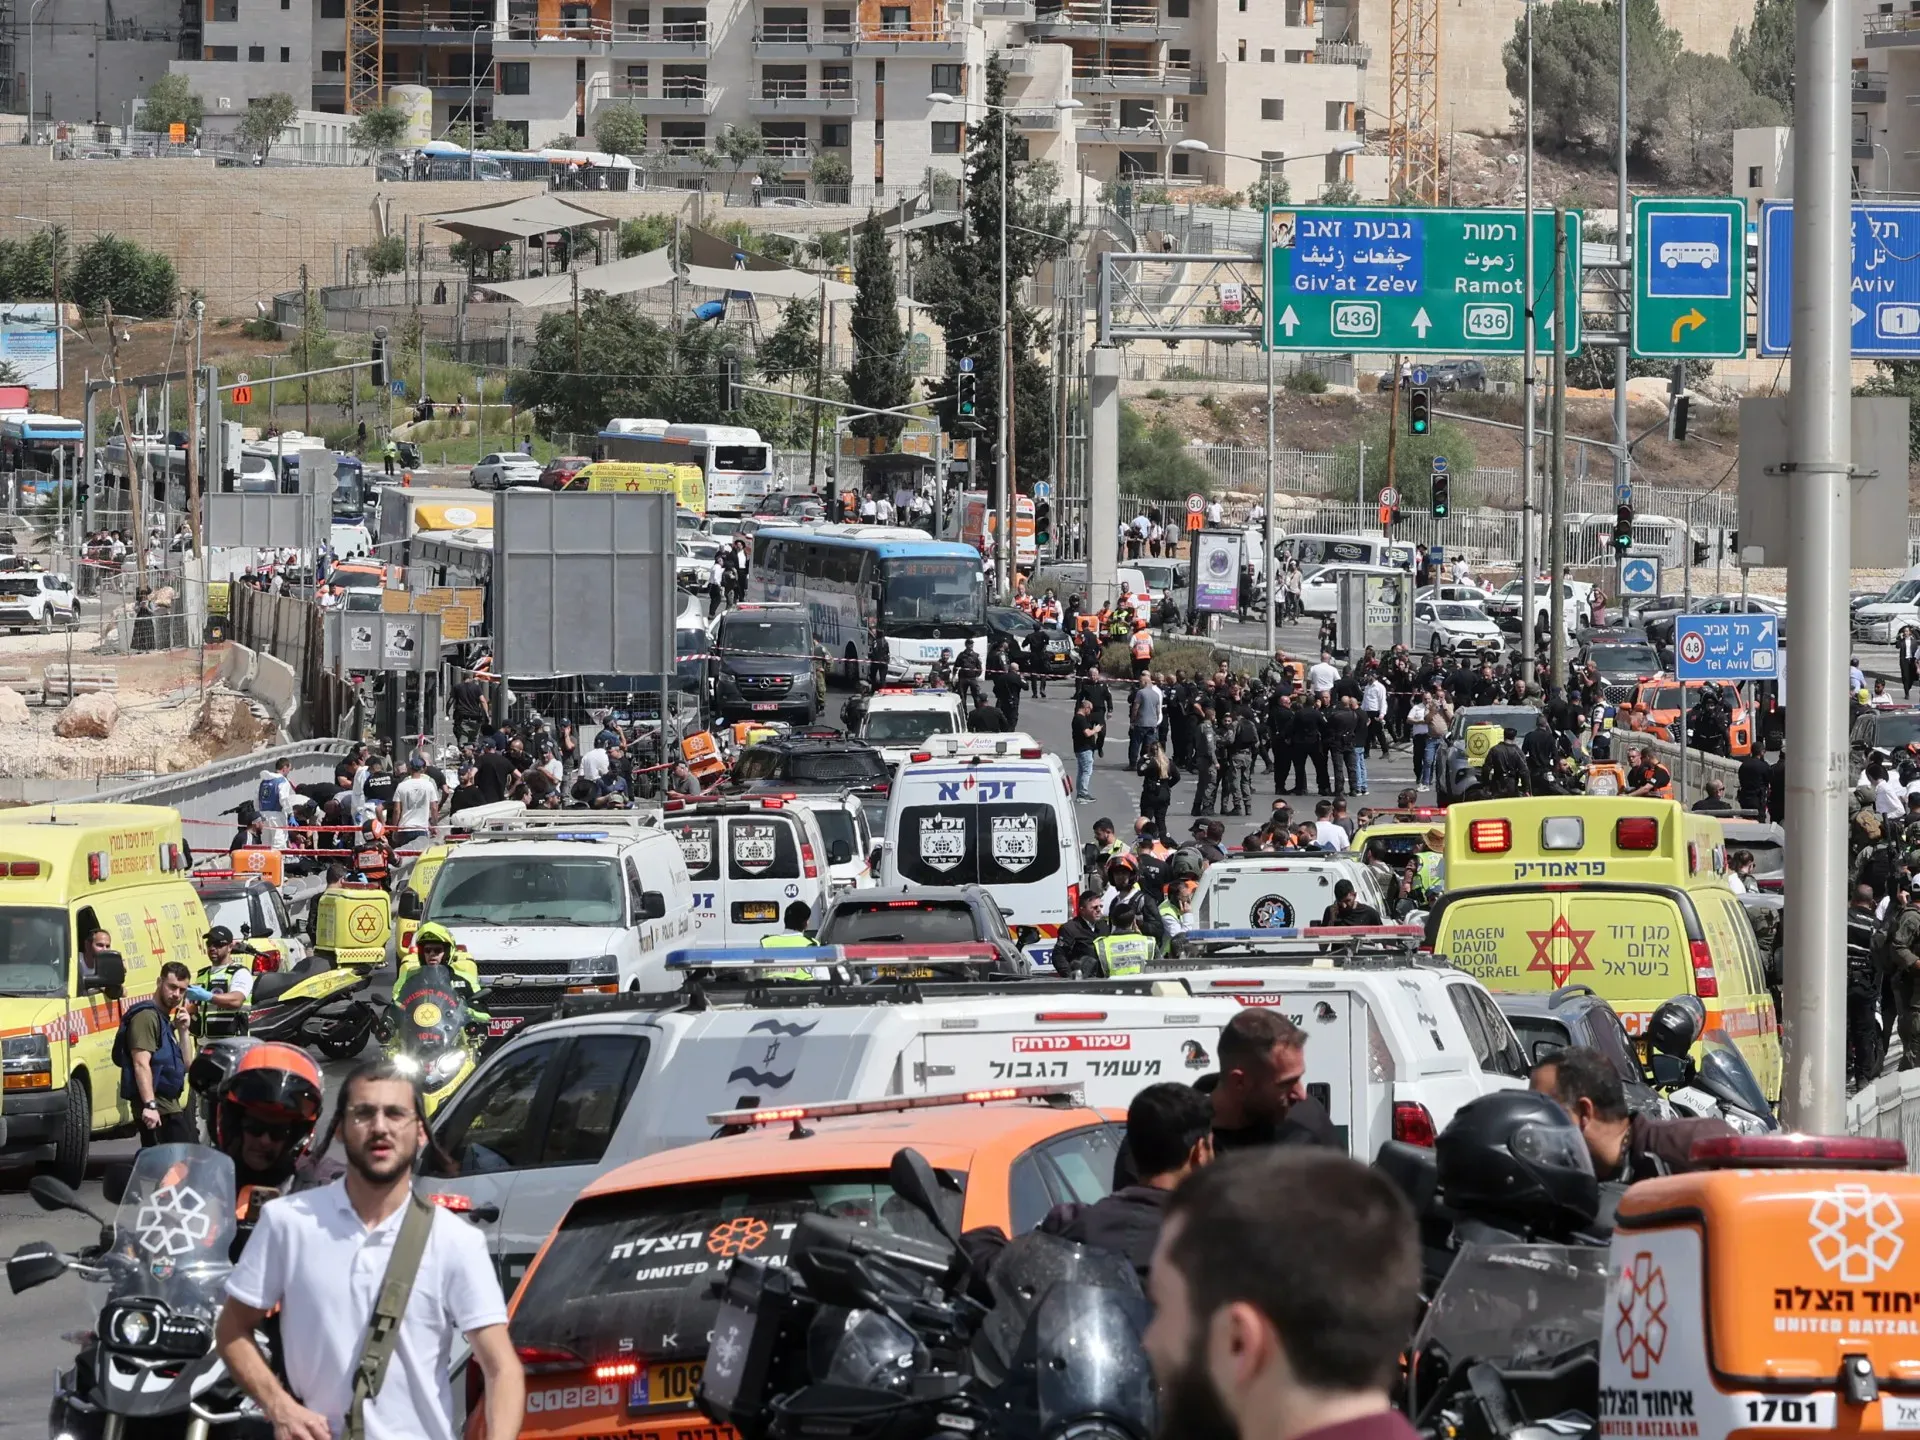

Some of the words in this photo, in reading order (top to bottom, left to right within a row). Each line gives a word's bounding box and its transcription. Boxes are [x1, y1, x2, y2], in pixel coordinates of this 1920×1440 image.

[1302, 220, 1342, 238] זאב
[1353, 221, 1411, 240] גבעת
[1462, 223, 1517, 240] רמות
[1294, 274, 1356, 291] Giv'at
[1366, 275, 1418, 292] Ze'ev
[1455, 277, 1523, 293] Ramot
[1851, 276, 1895, 292] Aviv
[1339, 311, 1373, 327] 436
[1471, 314, 1506, 329] 436
[1896, 313, 1904, 329] 1
[1190, 499, 1202, 509] 50
[1703, 624, 1729, 636] אביב
[1733, 621, 1750, 635] תל
[1685, 642, 1700, 653] 4.8
[1705, 659, 1721, 670] Tel
[1726, 659, 1749, 670] Aviv
[370, 780, 392, 788] POLICE
[1514, 861, 1605, 880] פראמדיק
[785, 885, 799, 897] 44
[1452, 927, 1505, 940] MAGEN
[1608, 924, 1635, 938] דוד
[1643, 925, 1670, 939] מגן
[1452, 941, 1497, 953] DAVID
[1627, 943, 1670, 958] אדום
[1453, 953, 1498, 966] ADOM
[1602, 959, 1670, 976] בישראל
[1474, 965, 1520, 978] ISRAEL
[1241, 995, 1280, 1004] שמור
[1014, 1036, 1070, 1052] מרחק
[1075, 1034, 1128, 1048] שמור
[989, 1060, 1068, 1079] הגבול
[1086, 1059, 1161, 1076] משמר
[610, 1231, 703, 1260] הצלה
[636, 1261, 709, 1281] UNITED
[1774, 1285, 1854, 1312] הצלה
[1774, 1317, 1843, 1333] UNITED
[548, 1386, 615, 1405] 1221
[1599, 1385, 1639, 1416] הצלה
[1641, 1390, 1695, 1418] איחוד
[1746, 1400, 1817, 1423] 1701
[1599, 1420, 1635, 1436] UNITED
[1636, 1421, 1698, 1437] HATZALAH
